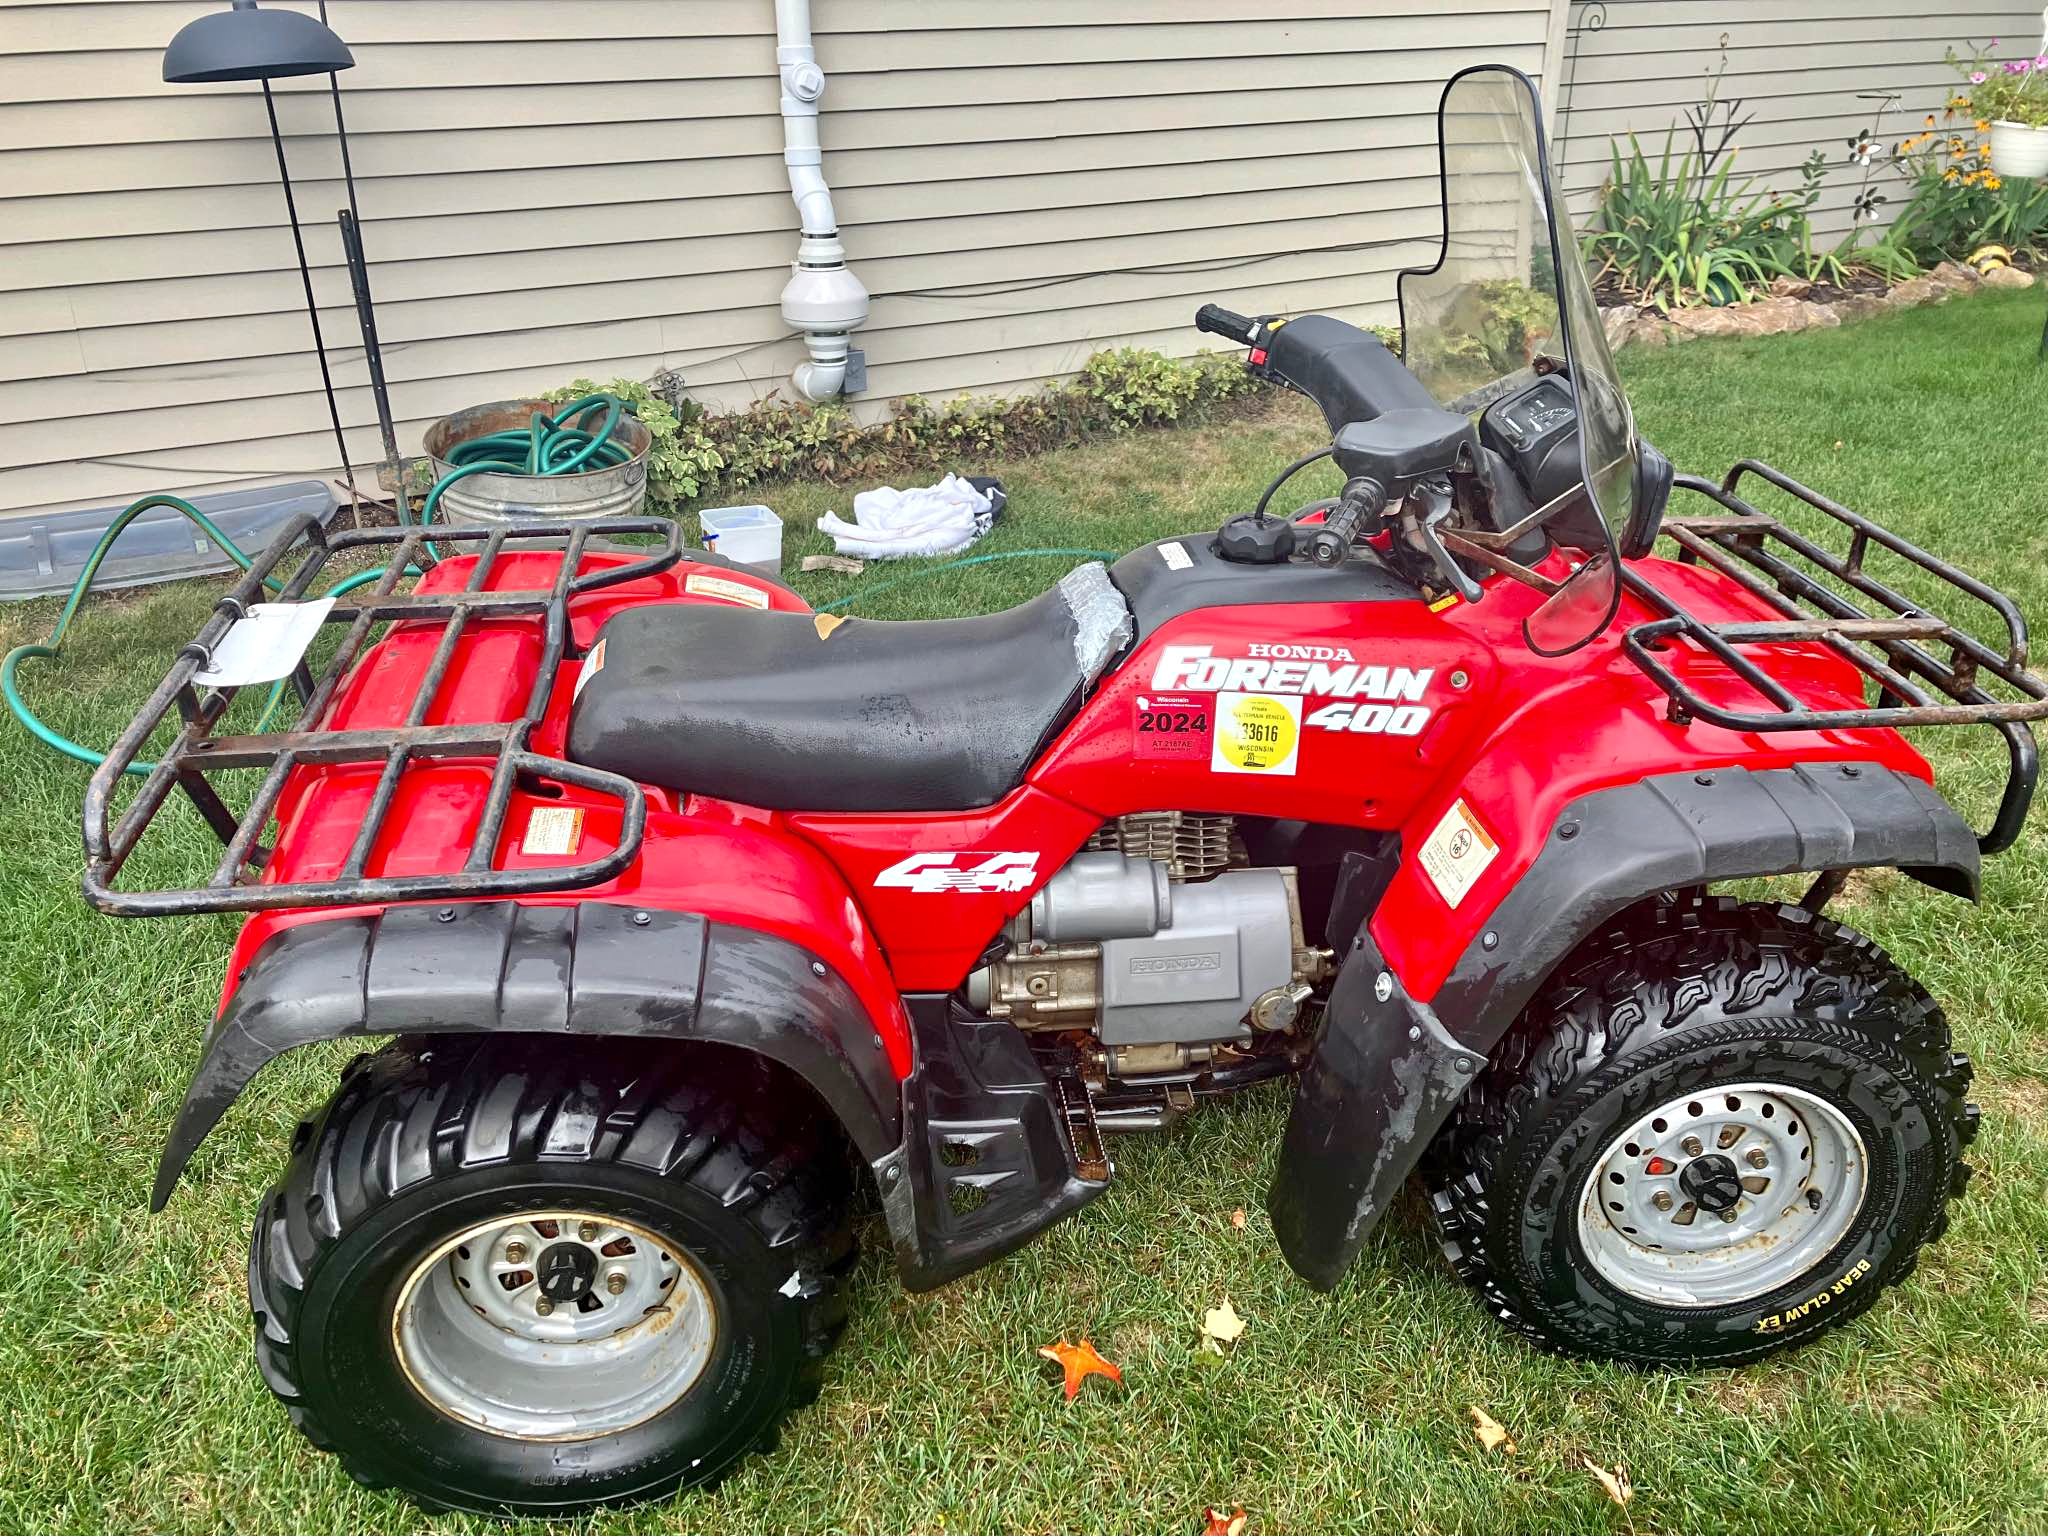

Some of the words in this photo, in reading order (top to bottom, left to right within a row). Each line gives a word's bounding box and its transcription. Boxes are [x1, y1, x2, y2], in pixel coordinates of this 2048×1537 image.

[1248, 644, 1355, 661] HONDA
[1156, 696, 1189, 704] Wisconsin
[1139, 712, 1207, 733] 2024
[1304, 702, 1431, 736] 400
[1237, 744, 1275, 753] WISCONSIN
[1133, 957, 1217, 972] HONDA
[1831, 1259, 1871, 1295] BEAR
[1785, 1292, 1831, 1323] CLAW
[1757, 1315, 1780, 1330] EX
